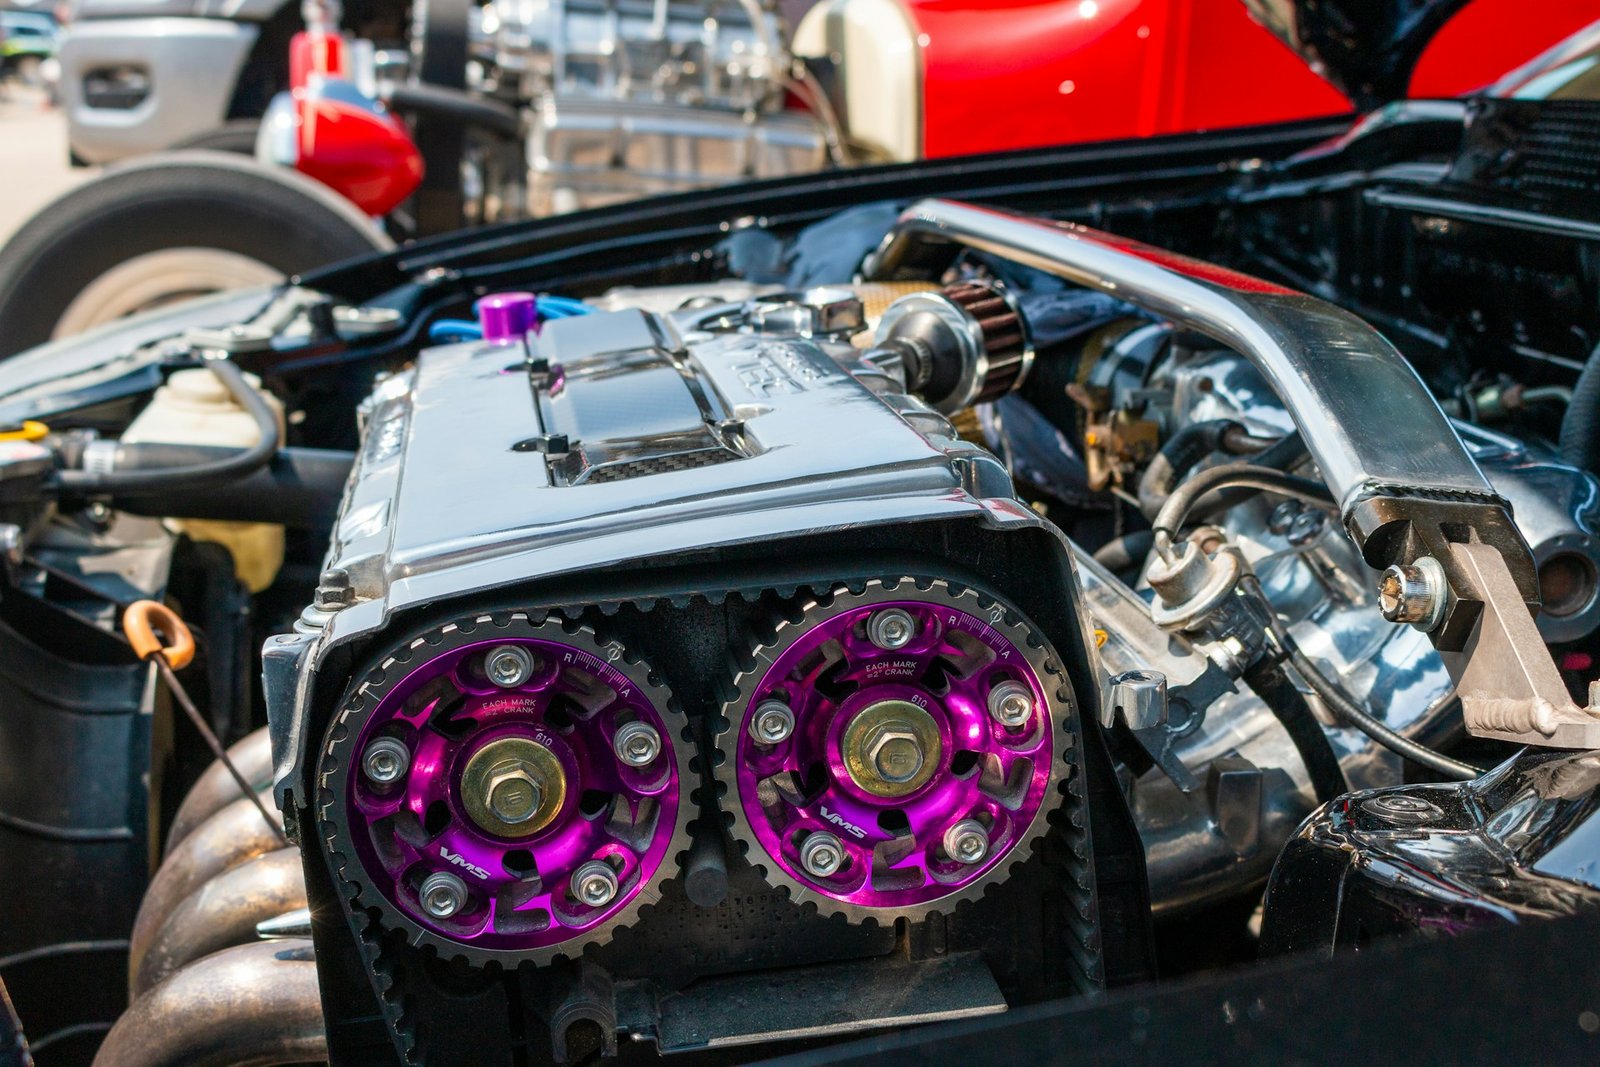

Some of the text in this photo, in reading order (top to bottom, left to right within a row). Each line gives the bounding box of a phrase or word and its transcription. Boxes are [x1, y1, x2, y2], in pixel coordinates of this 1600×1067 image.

[948, 615, 957, 625] R
[563, 652, 573, 663] R
[1001, 650, 1010, 660] A
[865, 660, 917, 672] EACH MARK
[884, 668, 914, 677] CRANK
[621, 688, 631, 698] A
[482, 698, 537, 710] EACH MARK
[911, 694, 928, 708] 610
[503, 706, 535, 714] CRANK
[535, 732, 552, 747] 610
[820, 805, 868, 839] VMS
[440, 846, 491, 880] VMS
